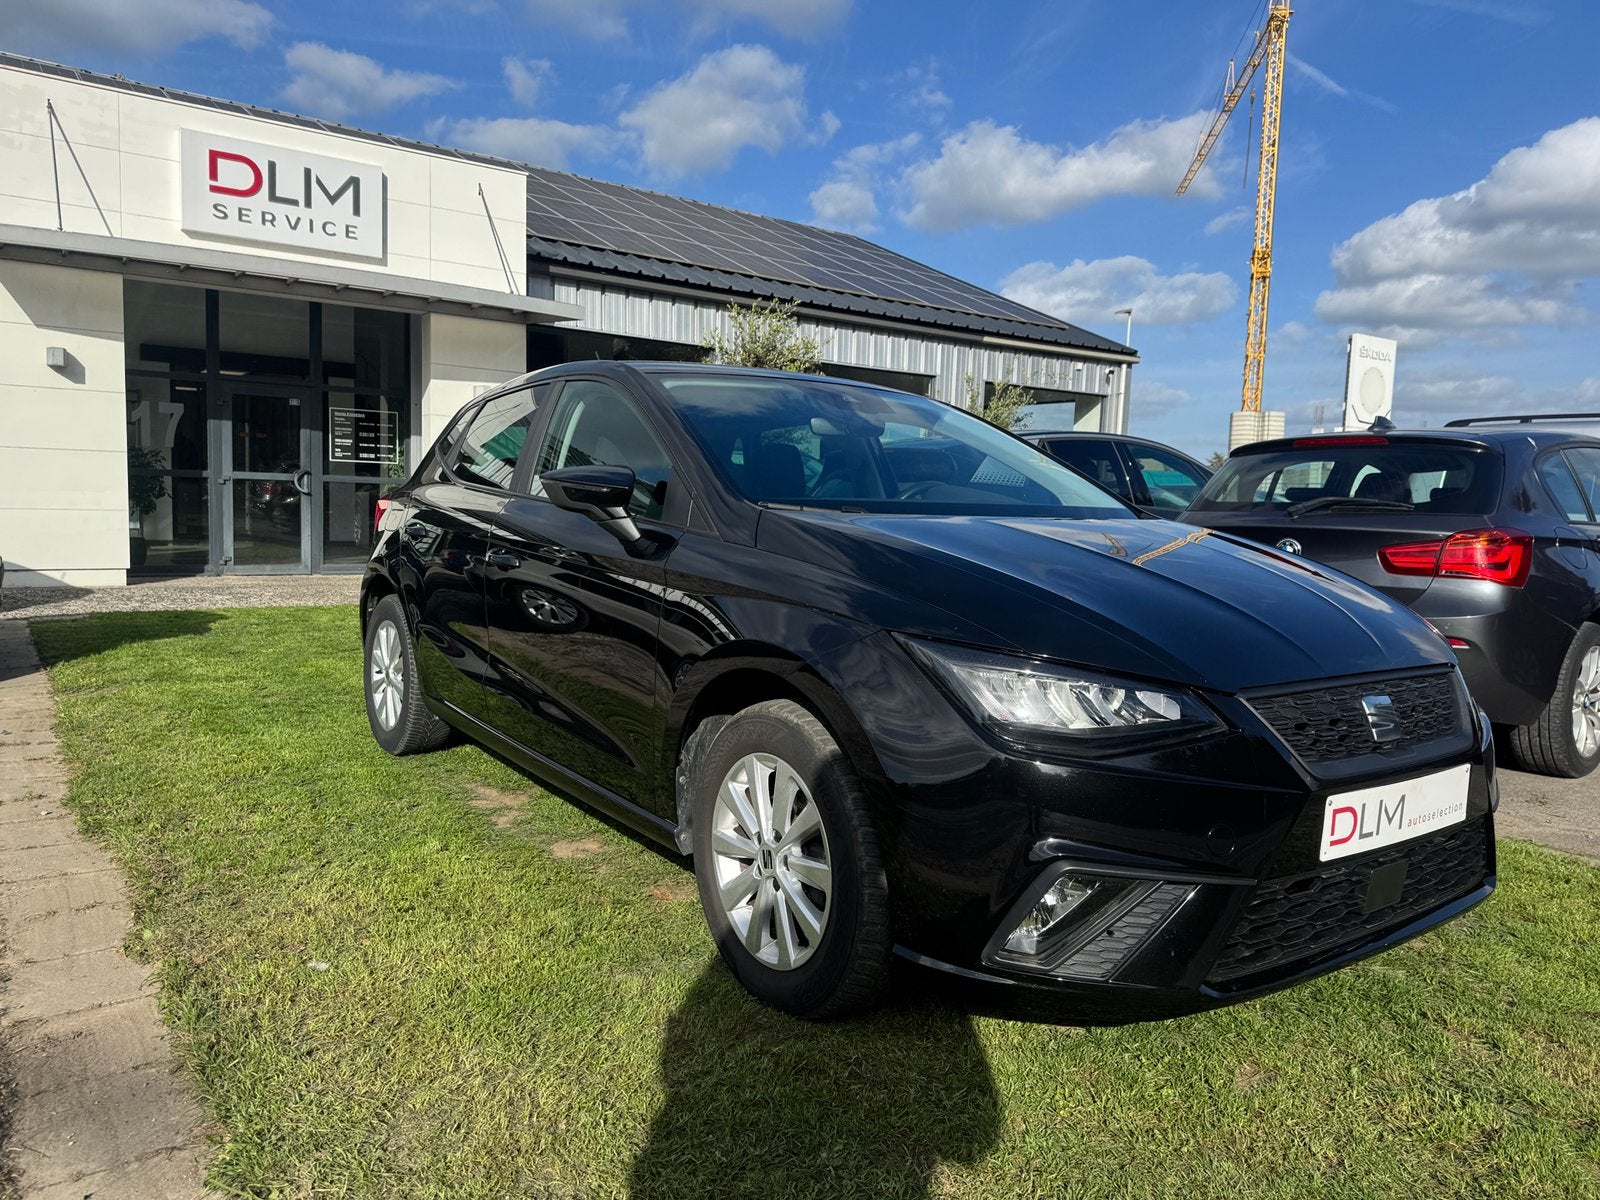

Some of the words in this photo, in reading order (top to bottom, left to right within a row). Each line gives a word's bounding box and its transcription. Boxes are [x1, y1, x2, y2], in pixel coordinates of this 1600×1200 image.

[212, 202, 359, 241] SERVICE
[131, 400, 185, 448] 17
[1407, 802, 1463, 828] autoselection
